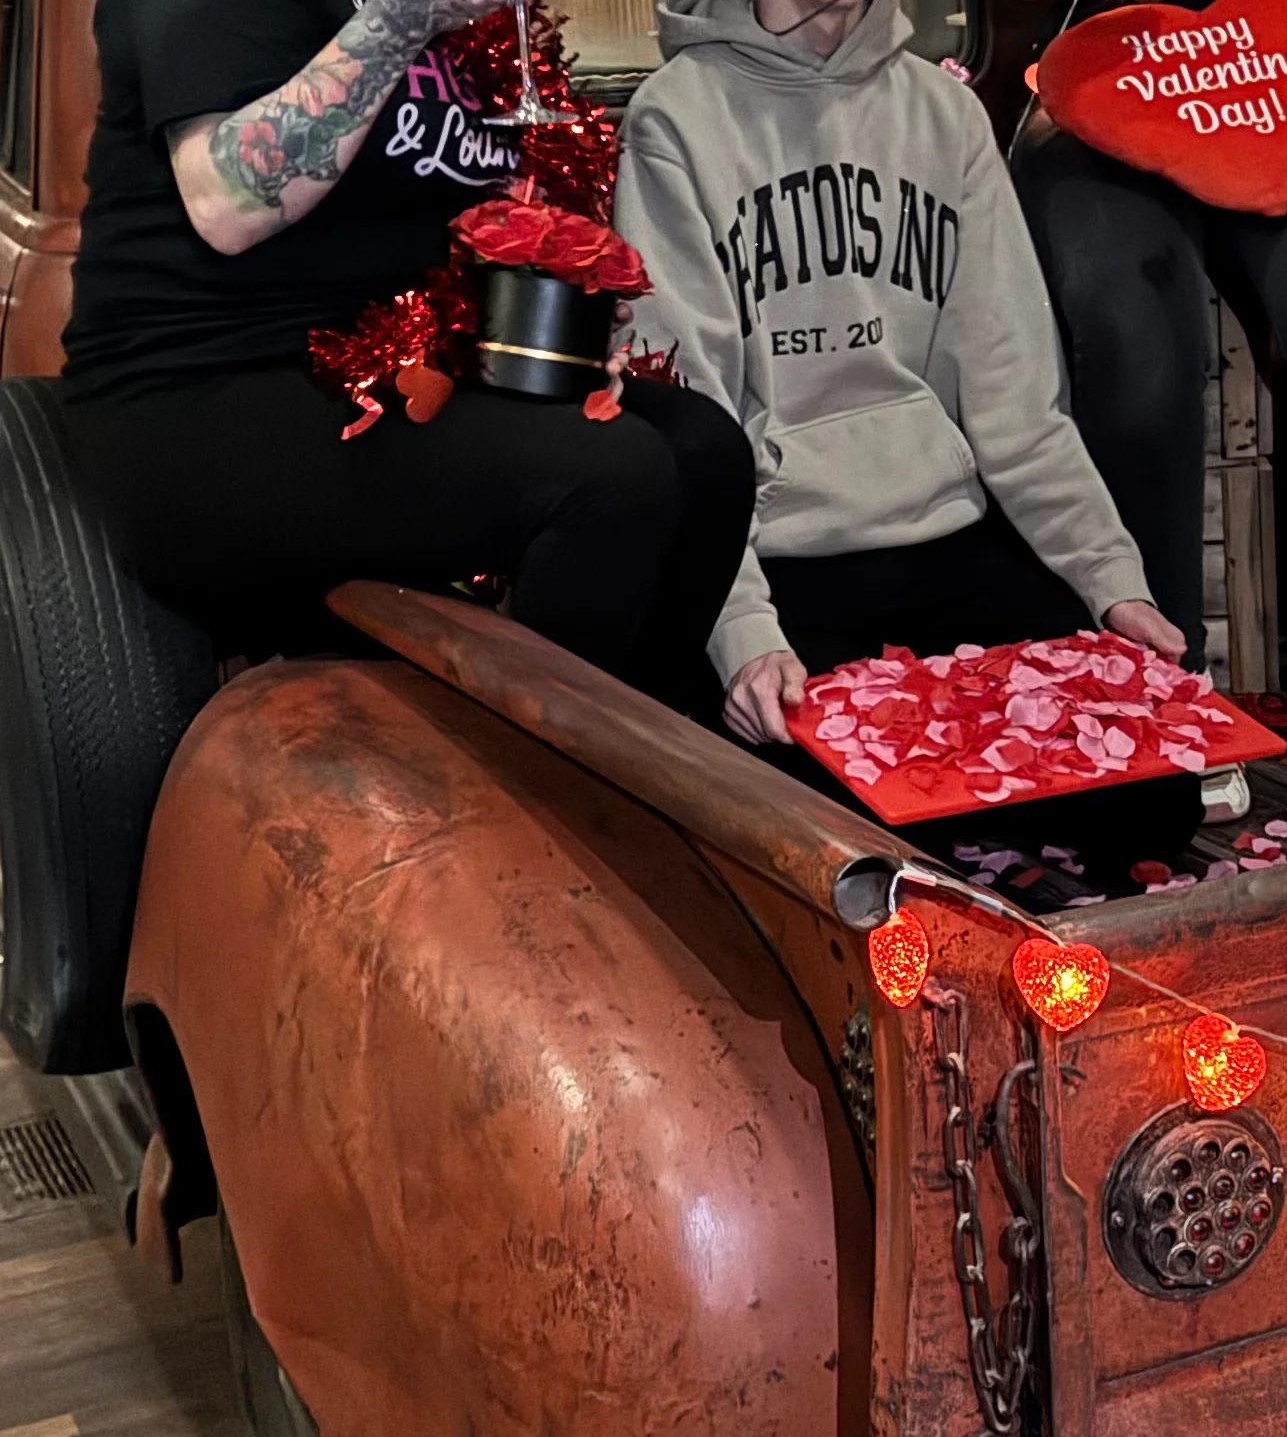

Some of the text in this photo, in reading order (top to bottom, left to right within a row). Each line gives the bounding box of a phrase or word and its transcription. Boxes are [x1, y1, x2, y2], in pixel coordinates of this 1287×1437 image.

[1121, 17, 1255, 63] Happy
[1177, 87, 1287, 135] Day!
[385, 102, 521, 186] & Loun
[771, 316, 884, 357] EST. 20
